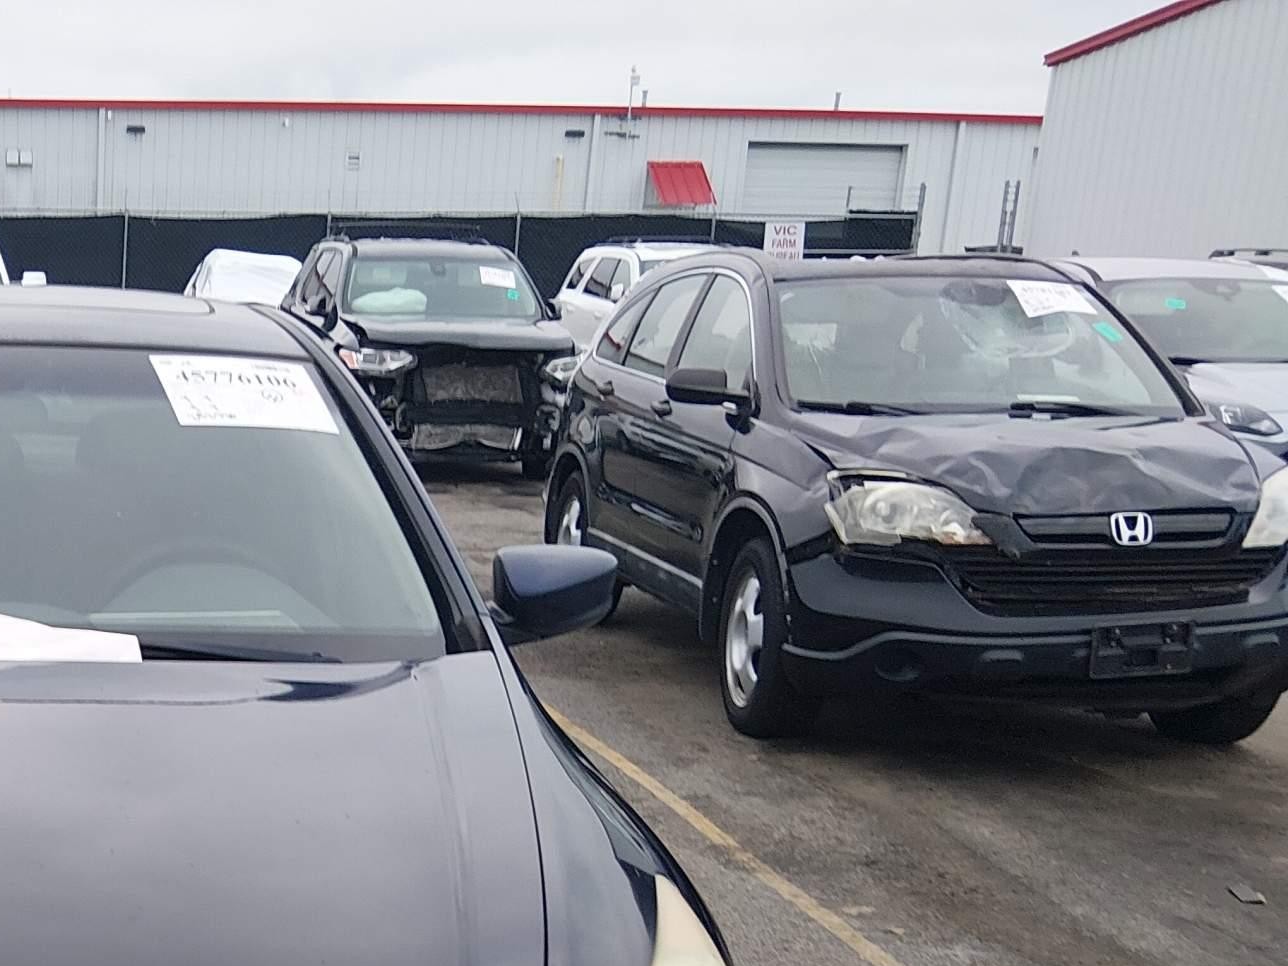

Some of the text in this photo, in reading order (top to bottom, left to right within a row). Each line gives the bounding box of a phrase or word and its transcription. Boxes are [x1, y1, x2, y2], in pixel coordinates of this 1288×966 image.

[774, 225, 798, 236] VIC
[771, 238, 797, 249] FARM
[176, 369, 297, 389] 45776106
